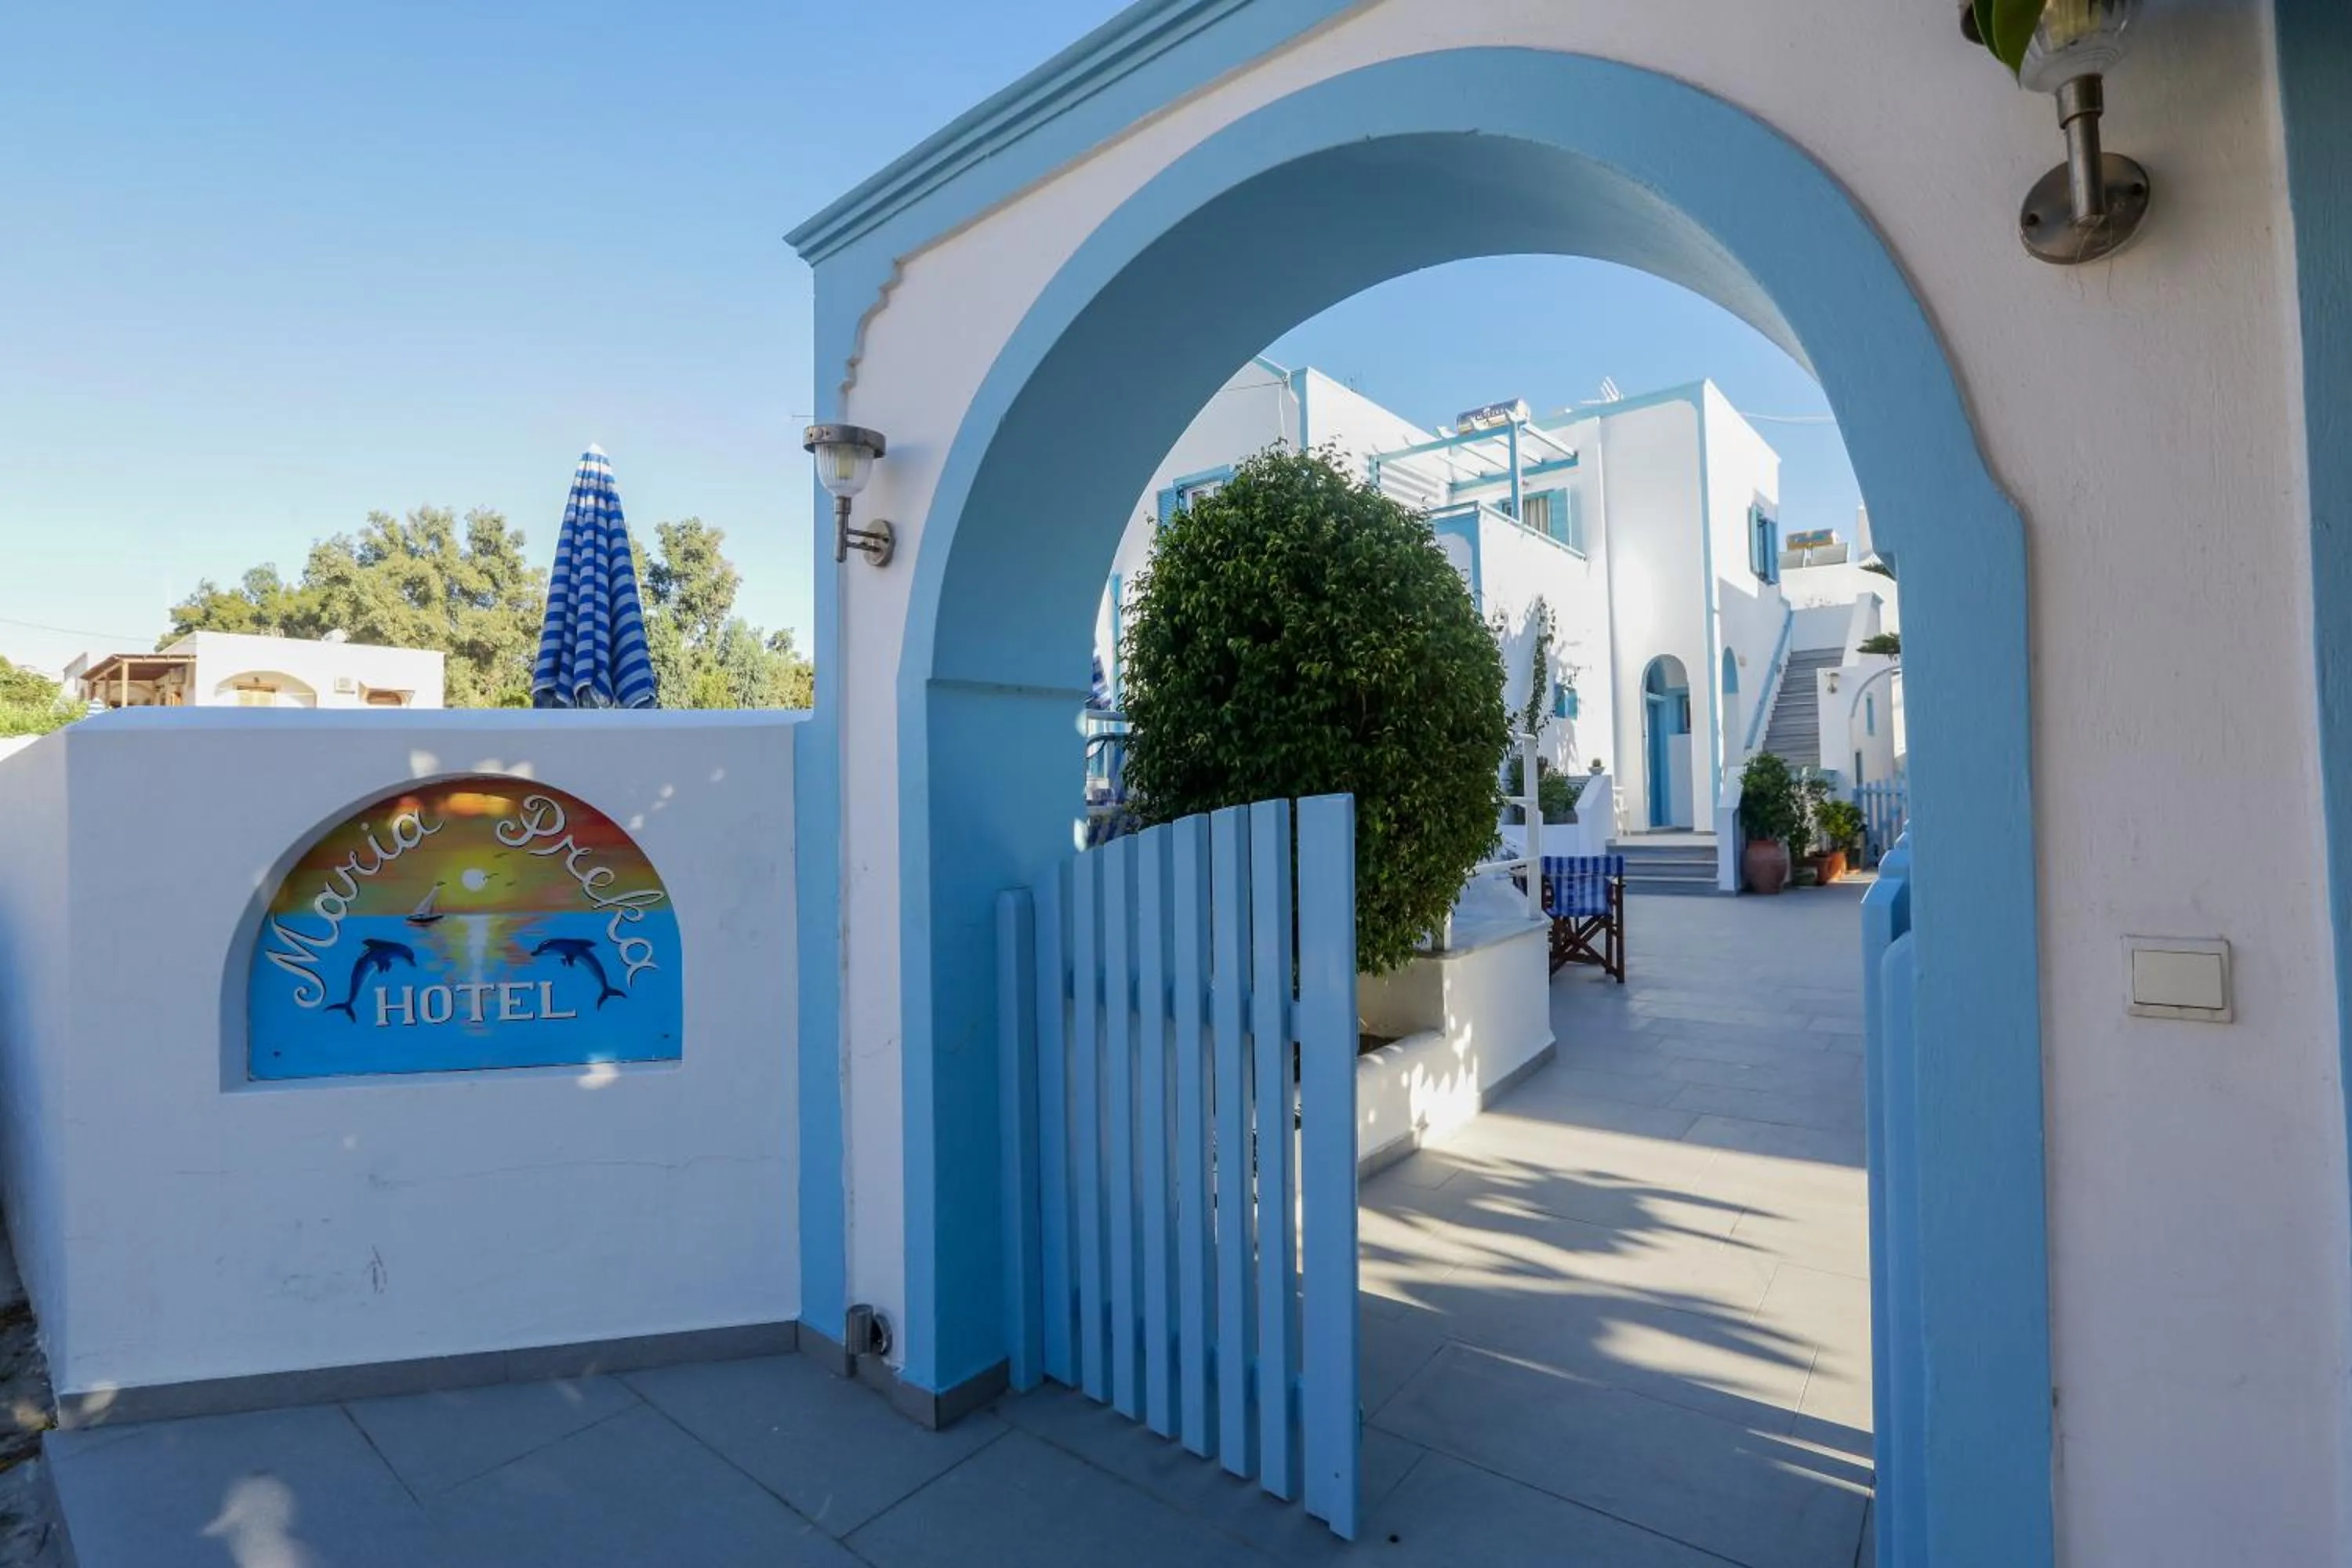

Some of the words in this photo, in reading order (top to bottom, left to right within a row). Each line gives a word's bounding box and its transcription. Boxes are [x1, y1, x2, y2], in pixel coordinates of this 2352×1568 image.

[265, 808, 446, 1008] Maria
[496, 794, 665, 989] Preka
[374, 981, 578, 1027] HOTEL
